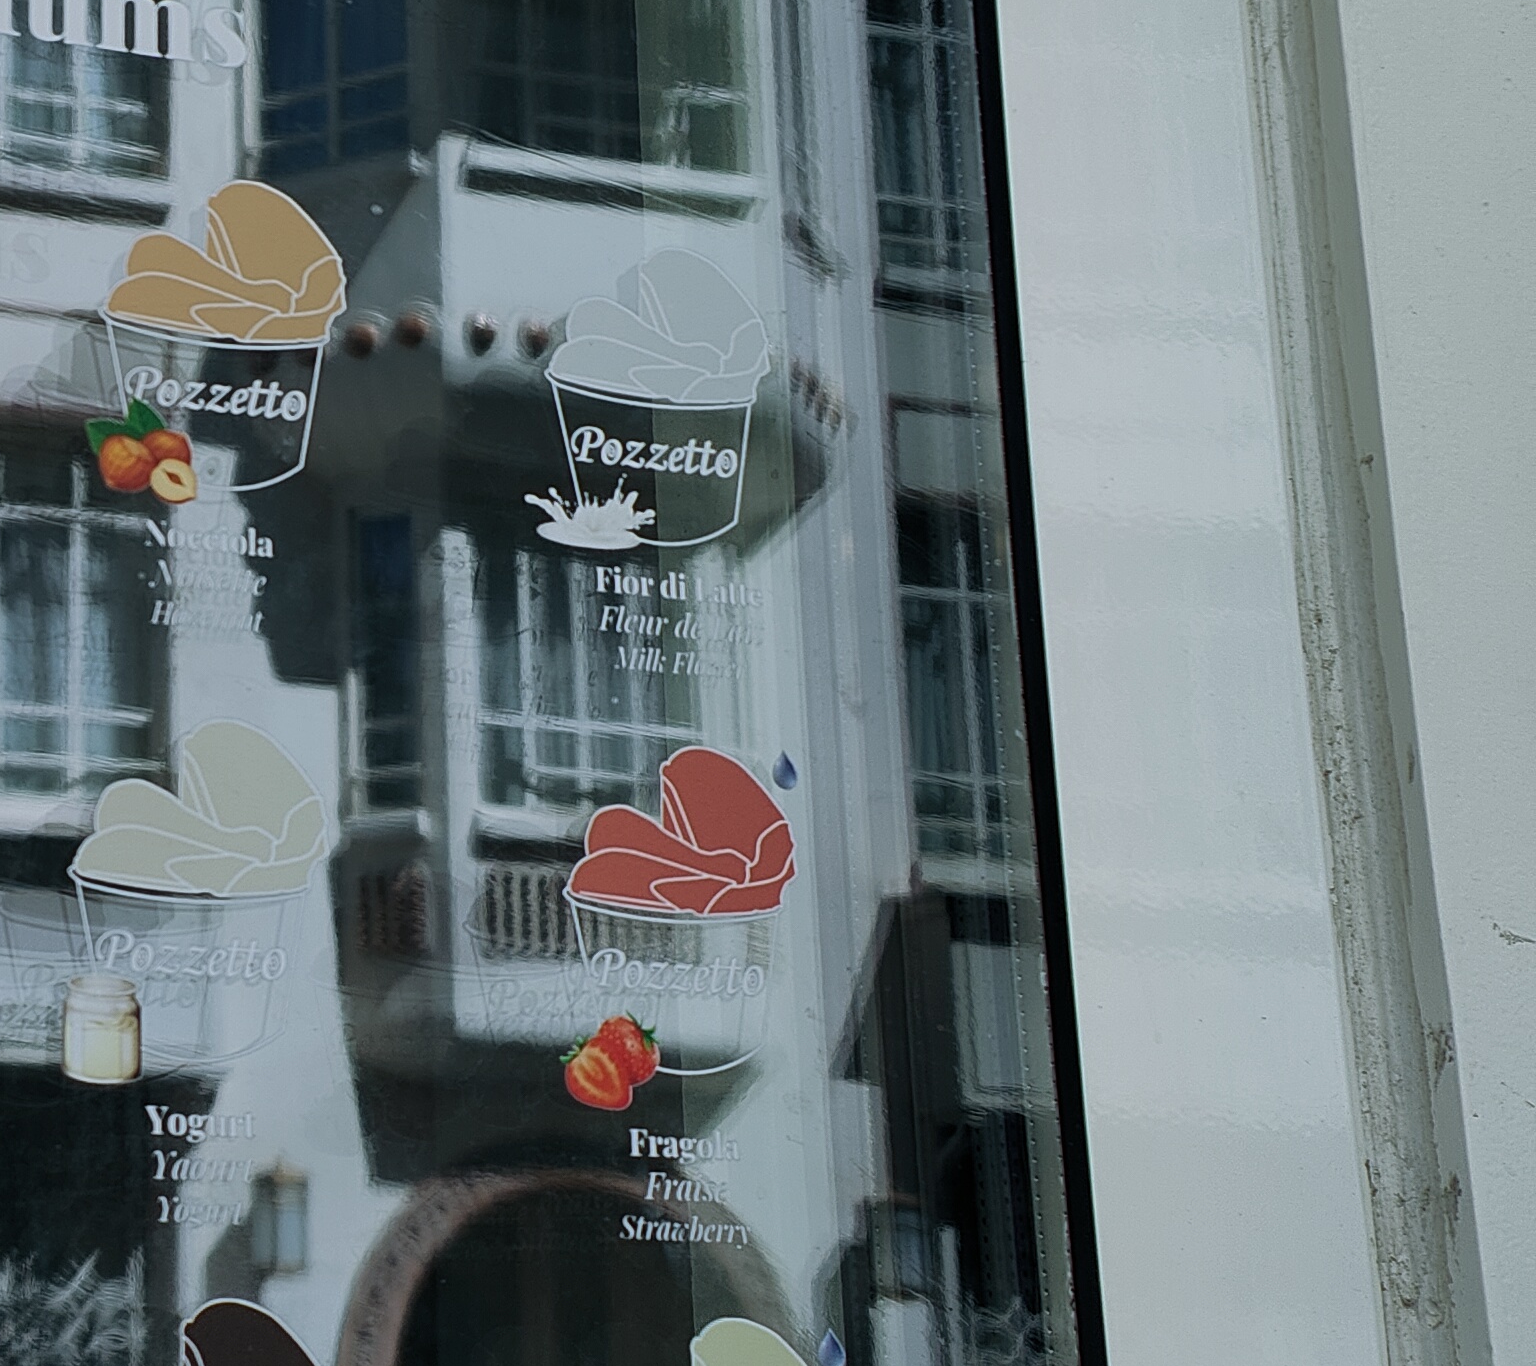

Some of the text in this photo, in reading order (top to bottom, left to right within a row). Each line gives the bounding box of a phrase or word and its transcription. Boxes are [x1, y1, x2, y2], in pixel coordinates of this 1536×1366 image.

[123, 364, 308, 422] Pozzetto
[570, 425, 739, 479] Pozzetto
[595, 565, 654, 599] Fior
[660, 570, 687, 602] di
[598, 604, 670, 637] Fleur
[614, 645, 667, 674] Milk
[95, 927, 288, 982] Pozzetto
[590, 947, 765, 998] Pozzetto
[144, 1104, 256, 1143] Yogurt
[628, 1127, 741, 1164] Fragola
[619, 1213, 751, 1250] Strawberry
